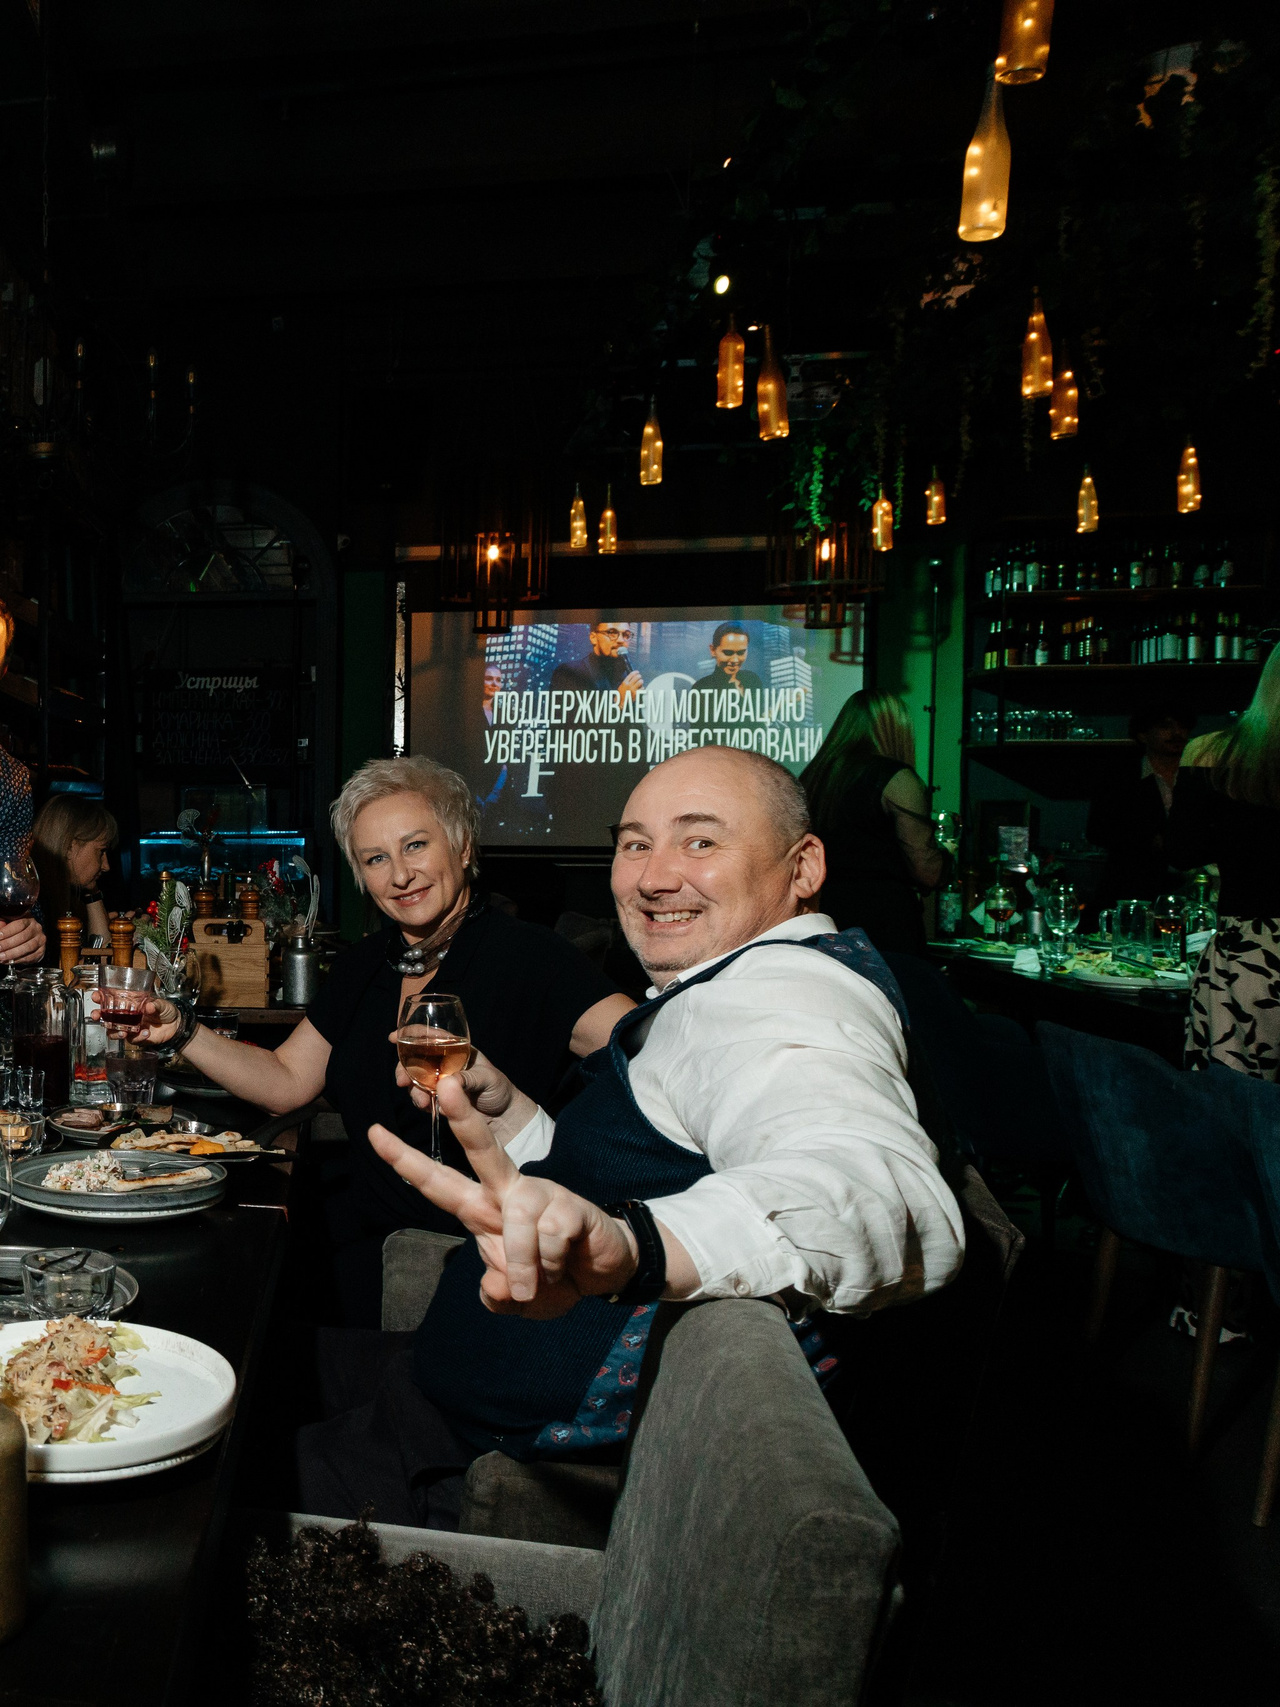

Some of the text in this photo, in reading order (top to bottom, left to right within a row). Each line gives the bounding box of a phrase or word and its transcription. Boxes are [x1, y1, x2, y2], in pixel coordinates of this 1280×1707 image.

[175, 671, 260, 696] Устрицы
[493, 688, 806, 728] ПОДДЕРЖИВАЕМ МОТИВАЦИЮ
[484, 729, 623, 764] УВЕРЕННОСТЬ
[628, 729, 641, 763] В
